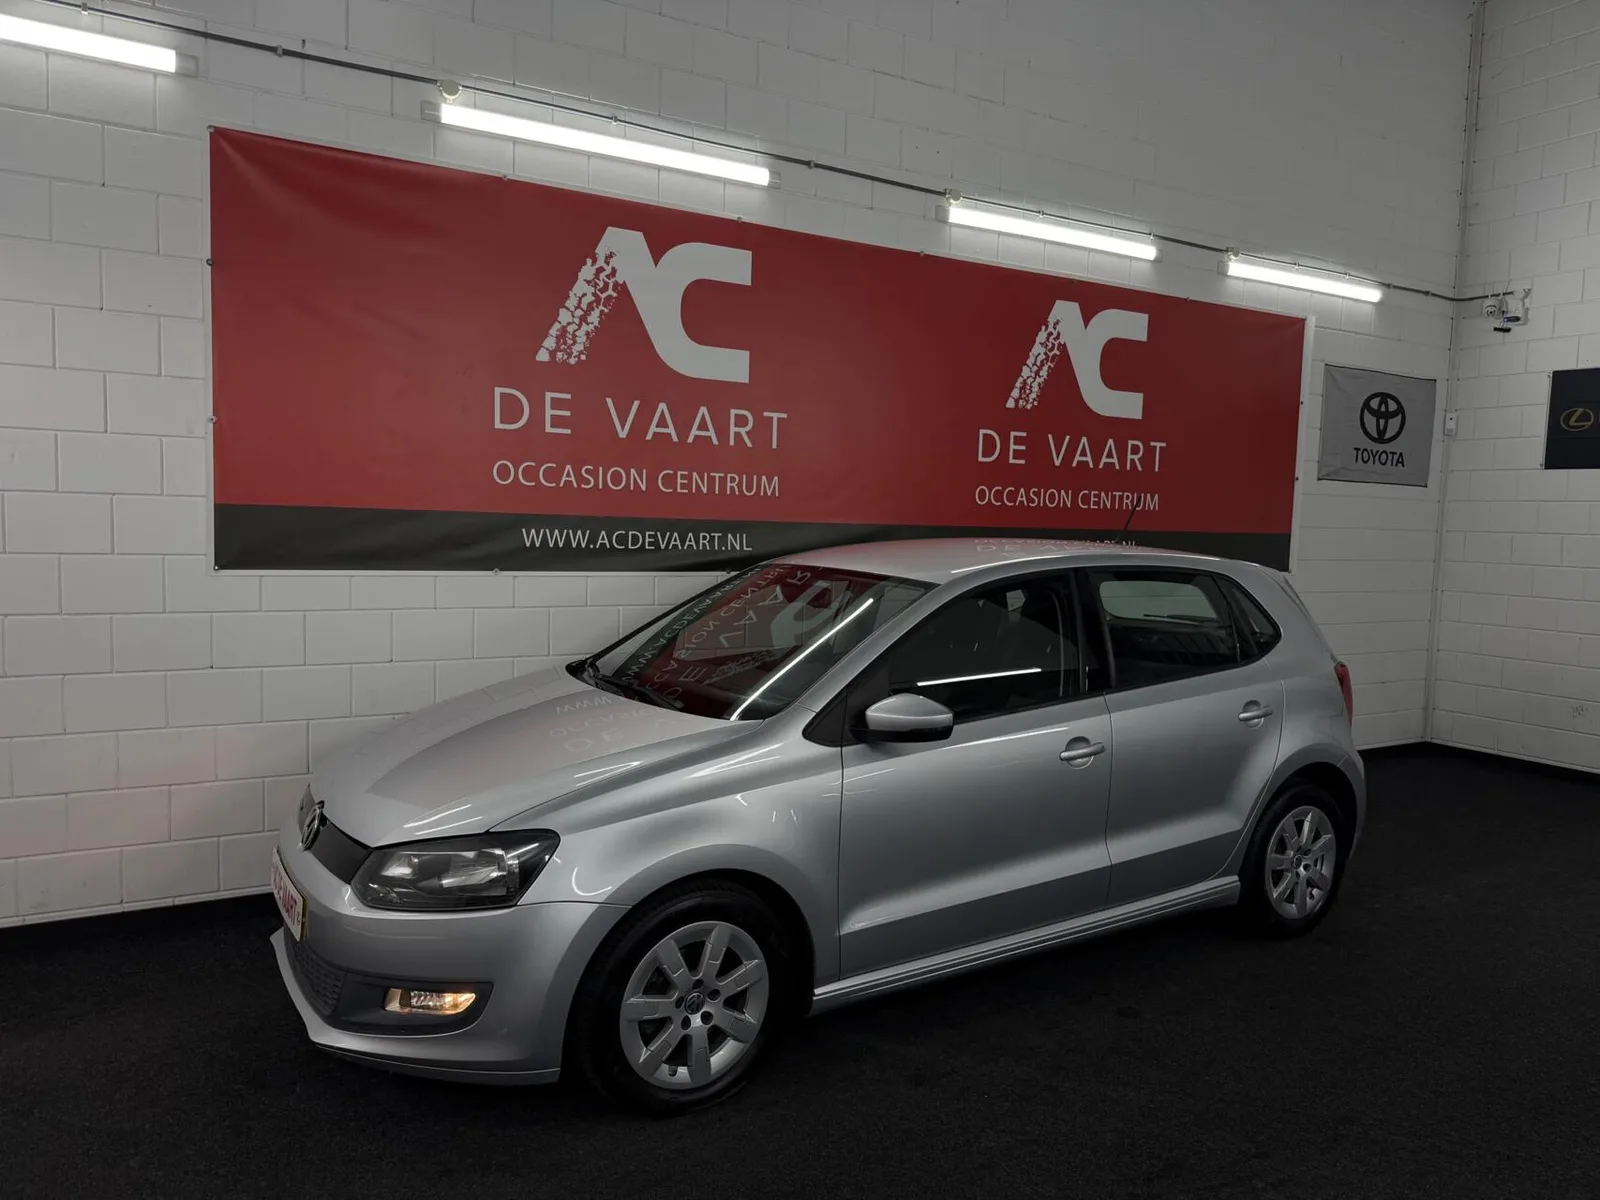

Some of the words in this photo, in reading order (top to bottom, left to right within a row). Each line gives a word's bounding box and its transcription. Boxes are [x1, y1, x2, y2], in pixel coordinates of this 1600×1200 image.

[535, 226, 752, 384] AC
[1005, 299, 1149, 420] AC
[494, 386, 572, 435] DE
[605, 397, 788, 449] VAART
[977, 428, 1027, 465] DE
[1048, 433, 1167, 472] VAART
[1353, 447, 1405, 468] TOYOTA
[492, 460, 647, 491] OCCASION
[657, 469, 779, 497] CENTRUM
[975, 485, 1072, 508] OCCASION
[1078, 490, 1159, 511] CENTRUM
[521, 528, 753, 551] WWW.ACDEVAART.NL
